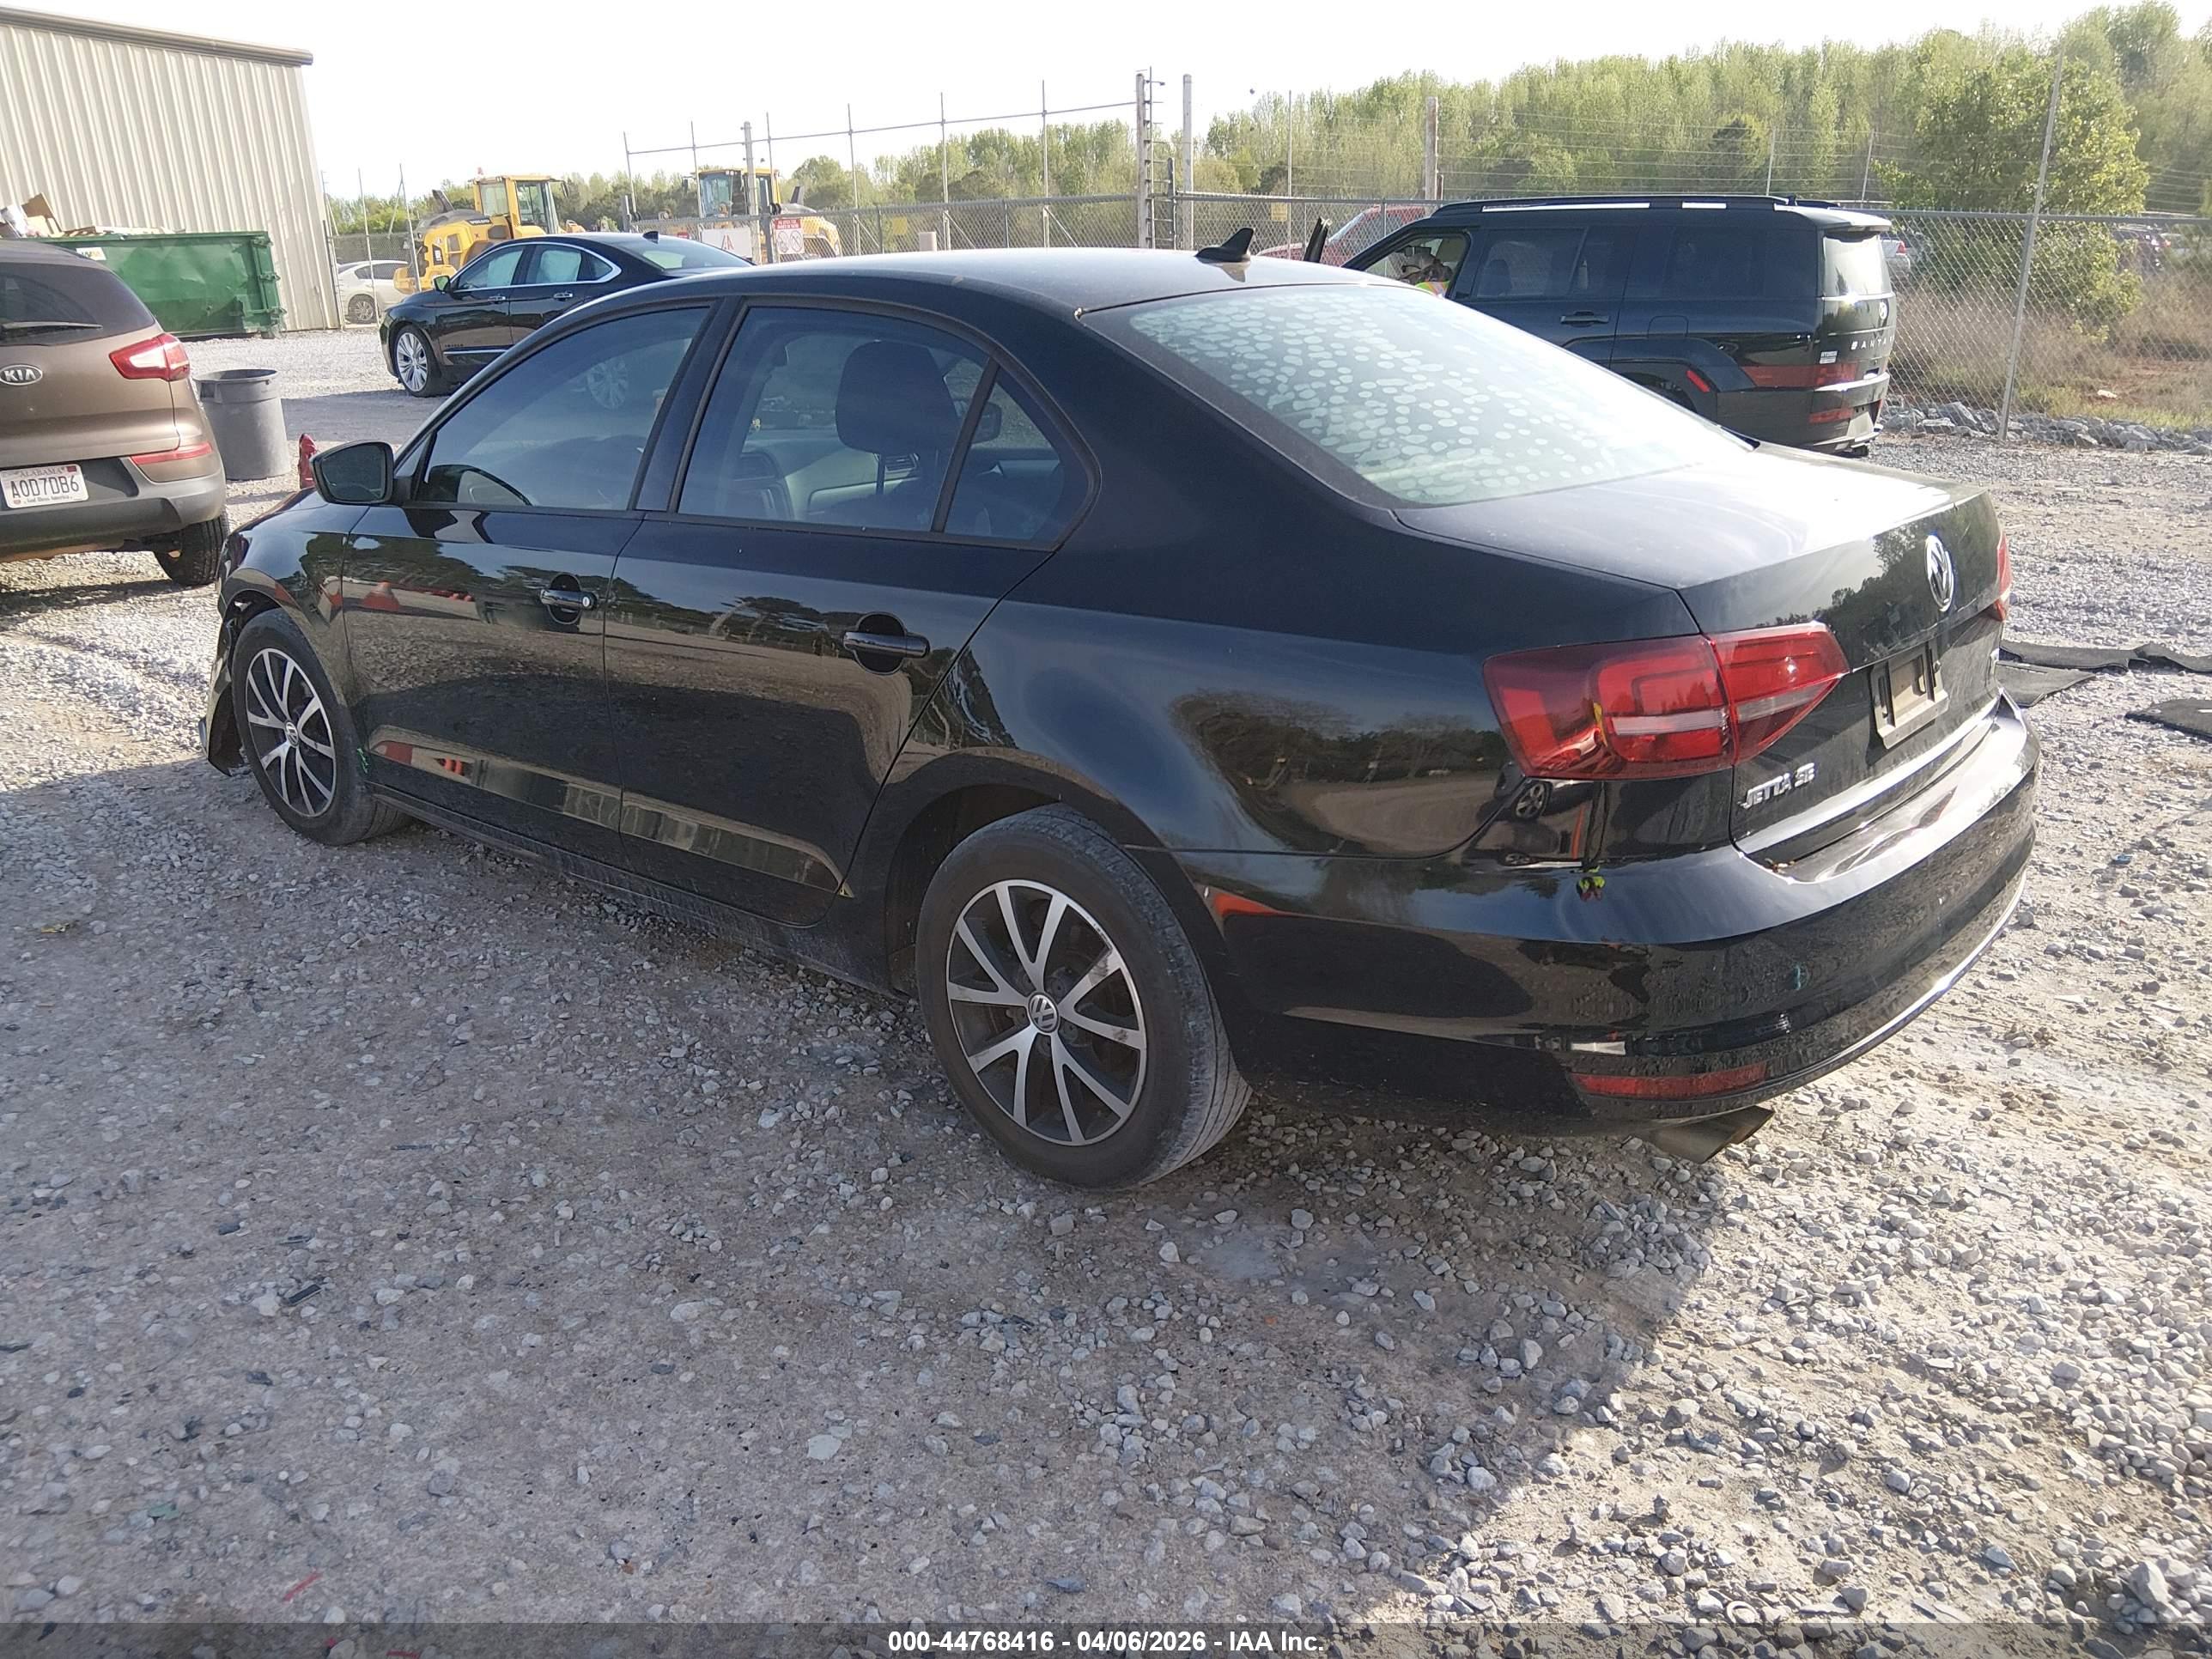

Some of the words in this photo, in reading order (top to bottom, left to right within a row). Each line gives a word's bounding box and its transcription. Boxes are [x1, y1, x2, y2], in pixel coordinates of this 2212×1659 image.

[3, 369, 36, 381] KIA
[20, 467, 63, 477] ALABAMA
[1736, 773, 1792, 810] JETTA
[1795, 763, 1815, 787] SE
